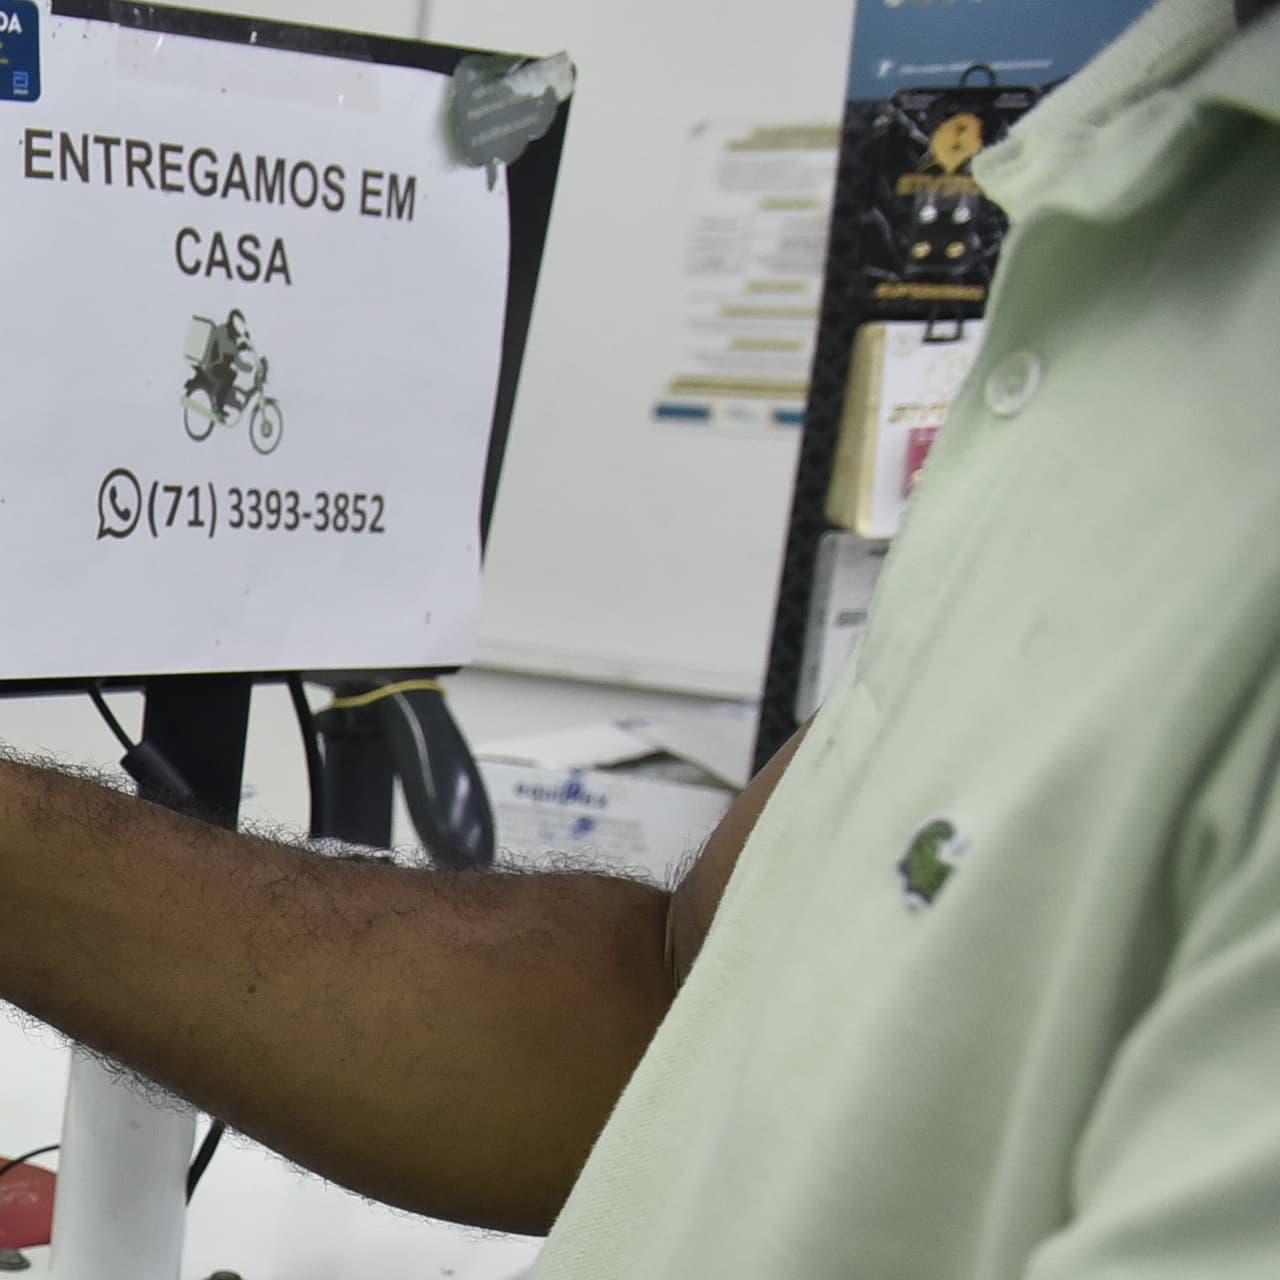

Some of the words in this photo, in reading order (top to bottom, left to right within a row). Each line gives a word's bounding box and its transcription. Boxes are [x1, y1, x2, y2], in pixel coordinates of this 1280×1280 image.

[22, 129, 346, 213] ENTREGAMOS
[359, 171, 417, 222] EM
[175, 227, 294, 286] CASA
[147, 483, 218, 535] (71)
[227, 487, 386, 535] 3393-3852
